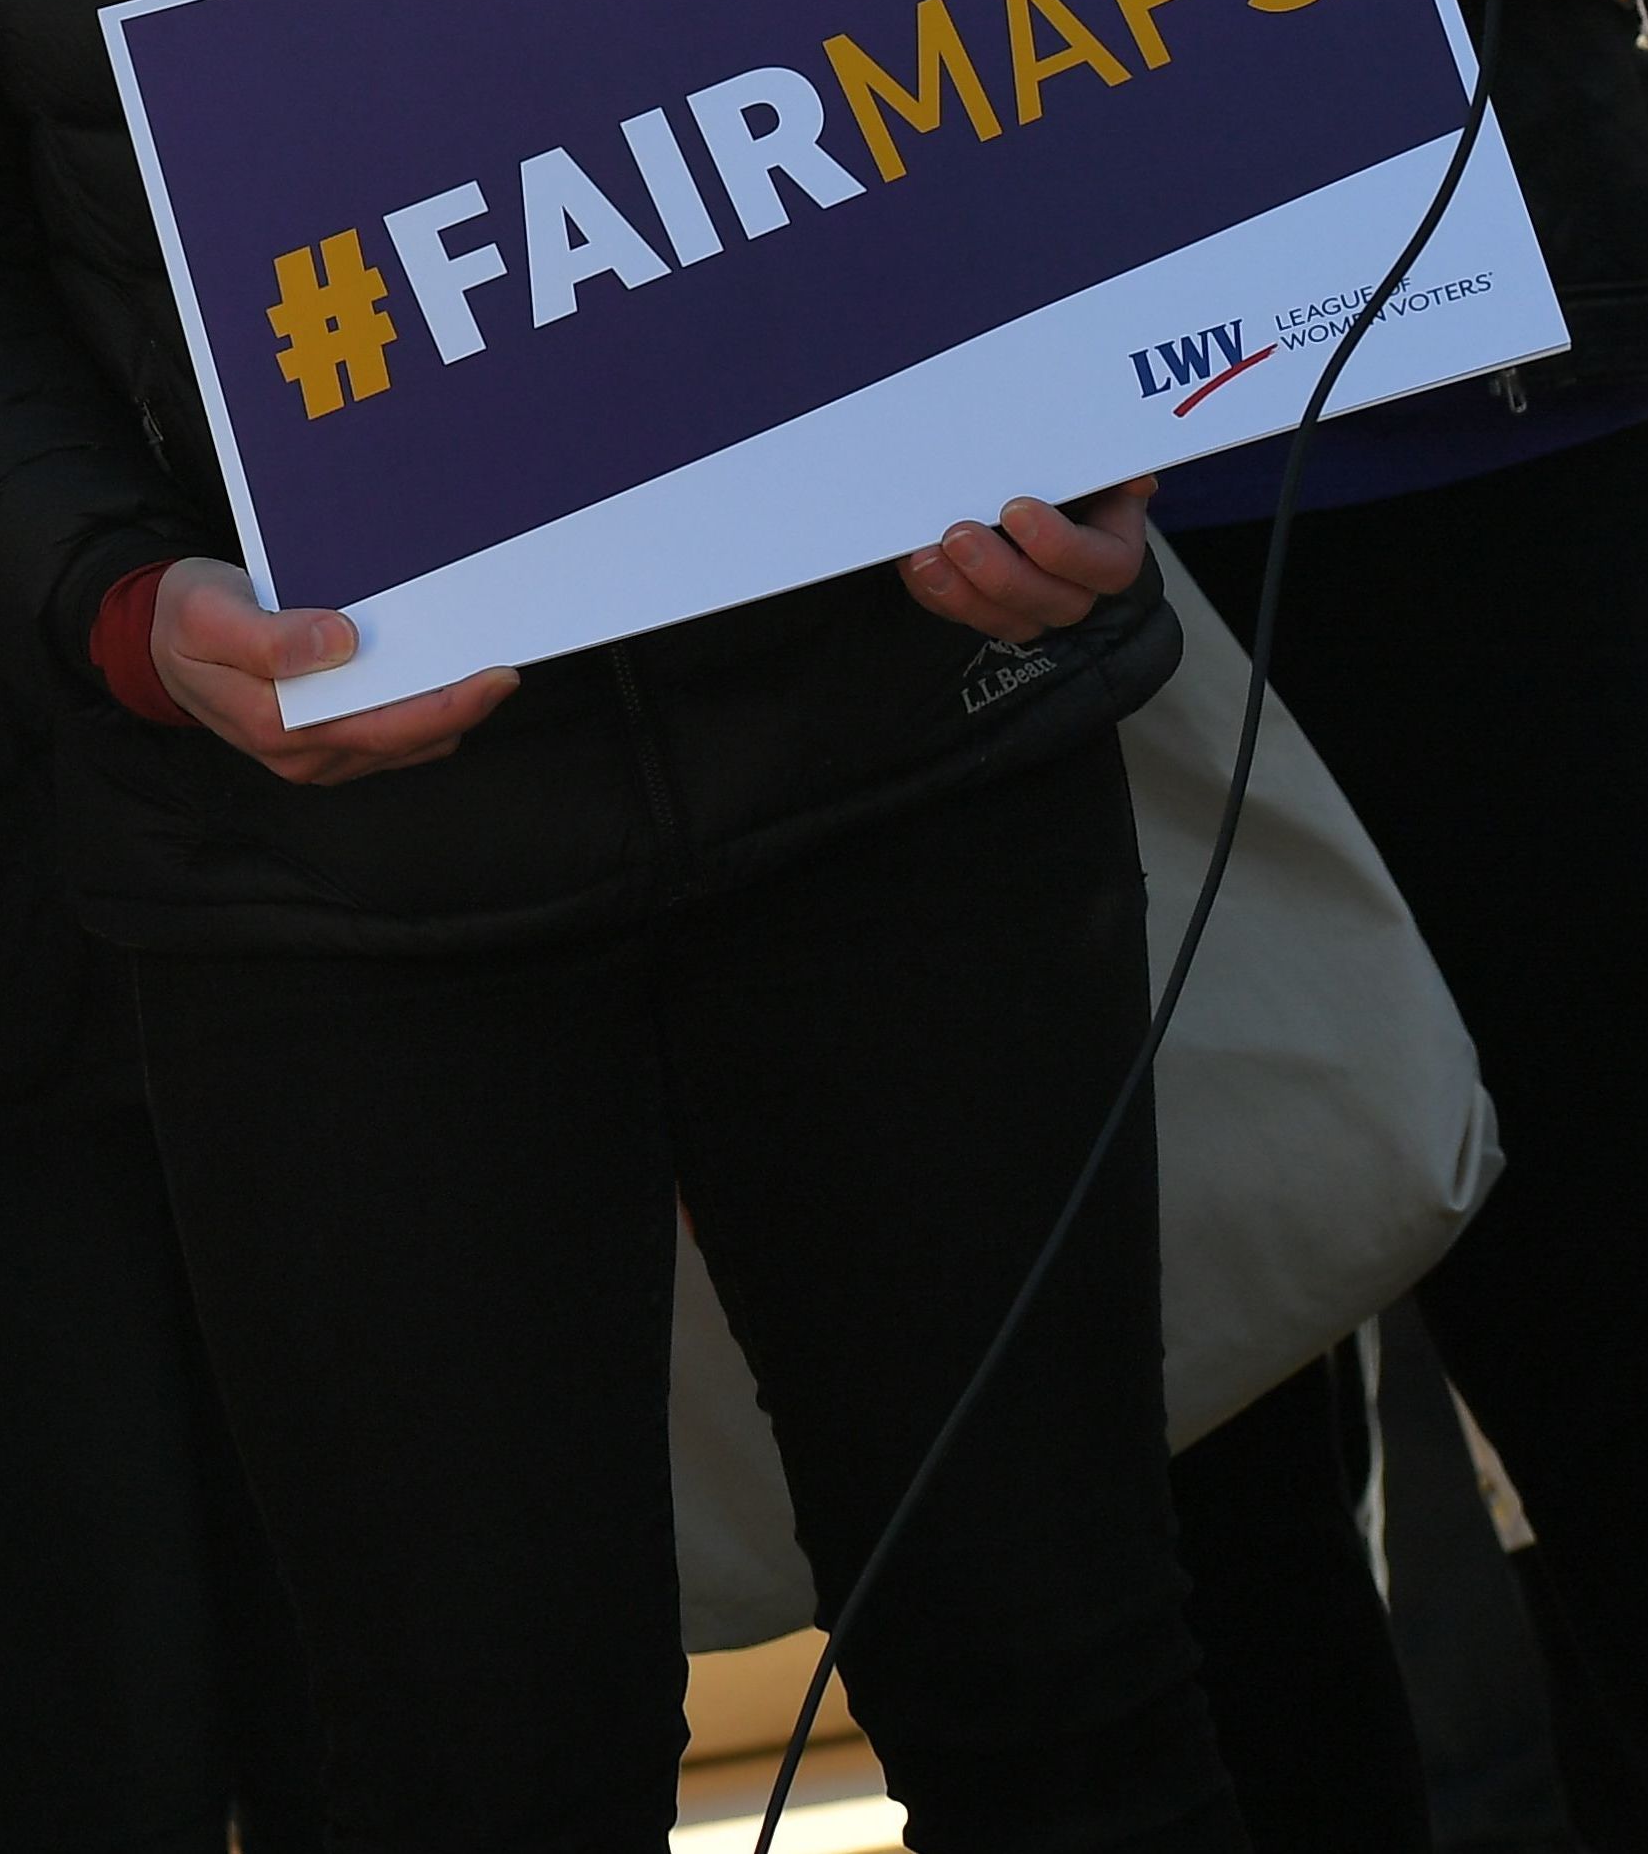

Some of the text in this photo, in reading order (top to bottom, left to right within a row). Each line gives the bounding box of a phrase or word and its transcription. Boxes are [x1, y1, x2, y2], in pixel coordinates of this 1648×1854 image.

[1274, 284, 1374, 332] LEAGUE
[1279, 272, 1493, 351] WOMN VOTERS
[1128, 318, 1244, 399] LWV
[960, 654, 1057, 715] L.L.Bean
